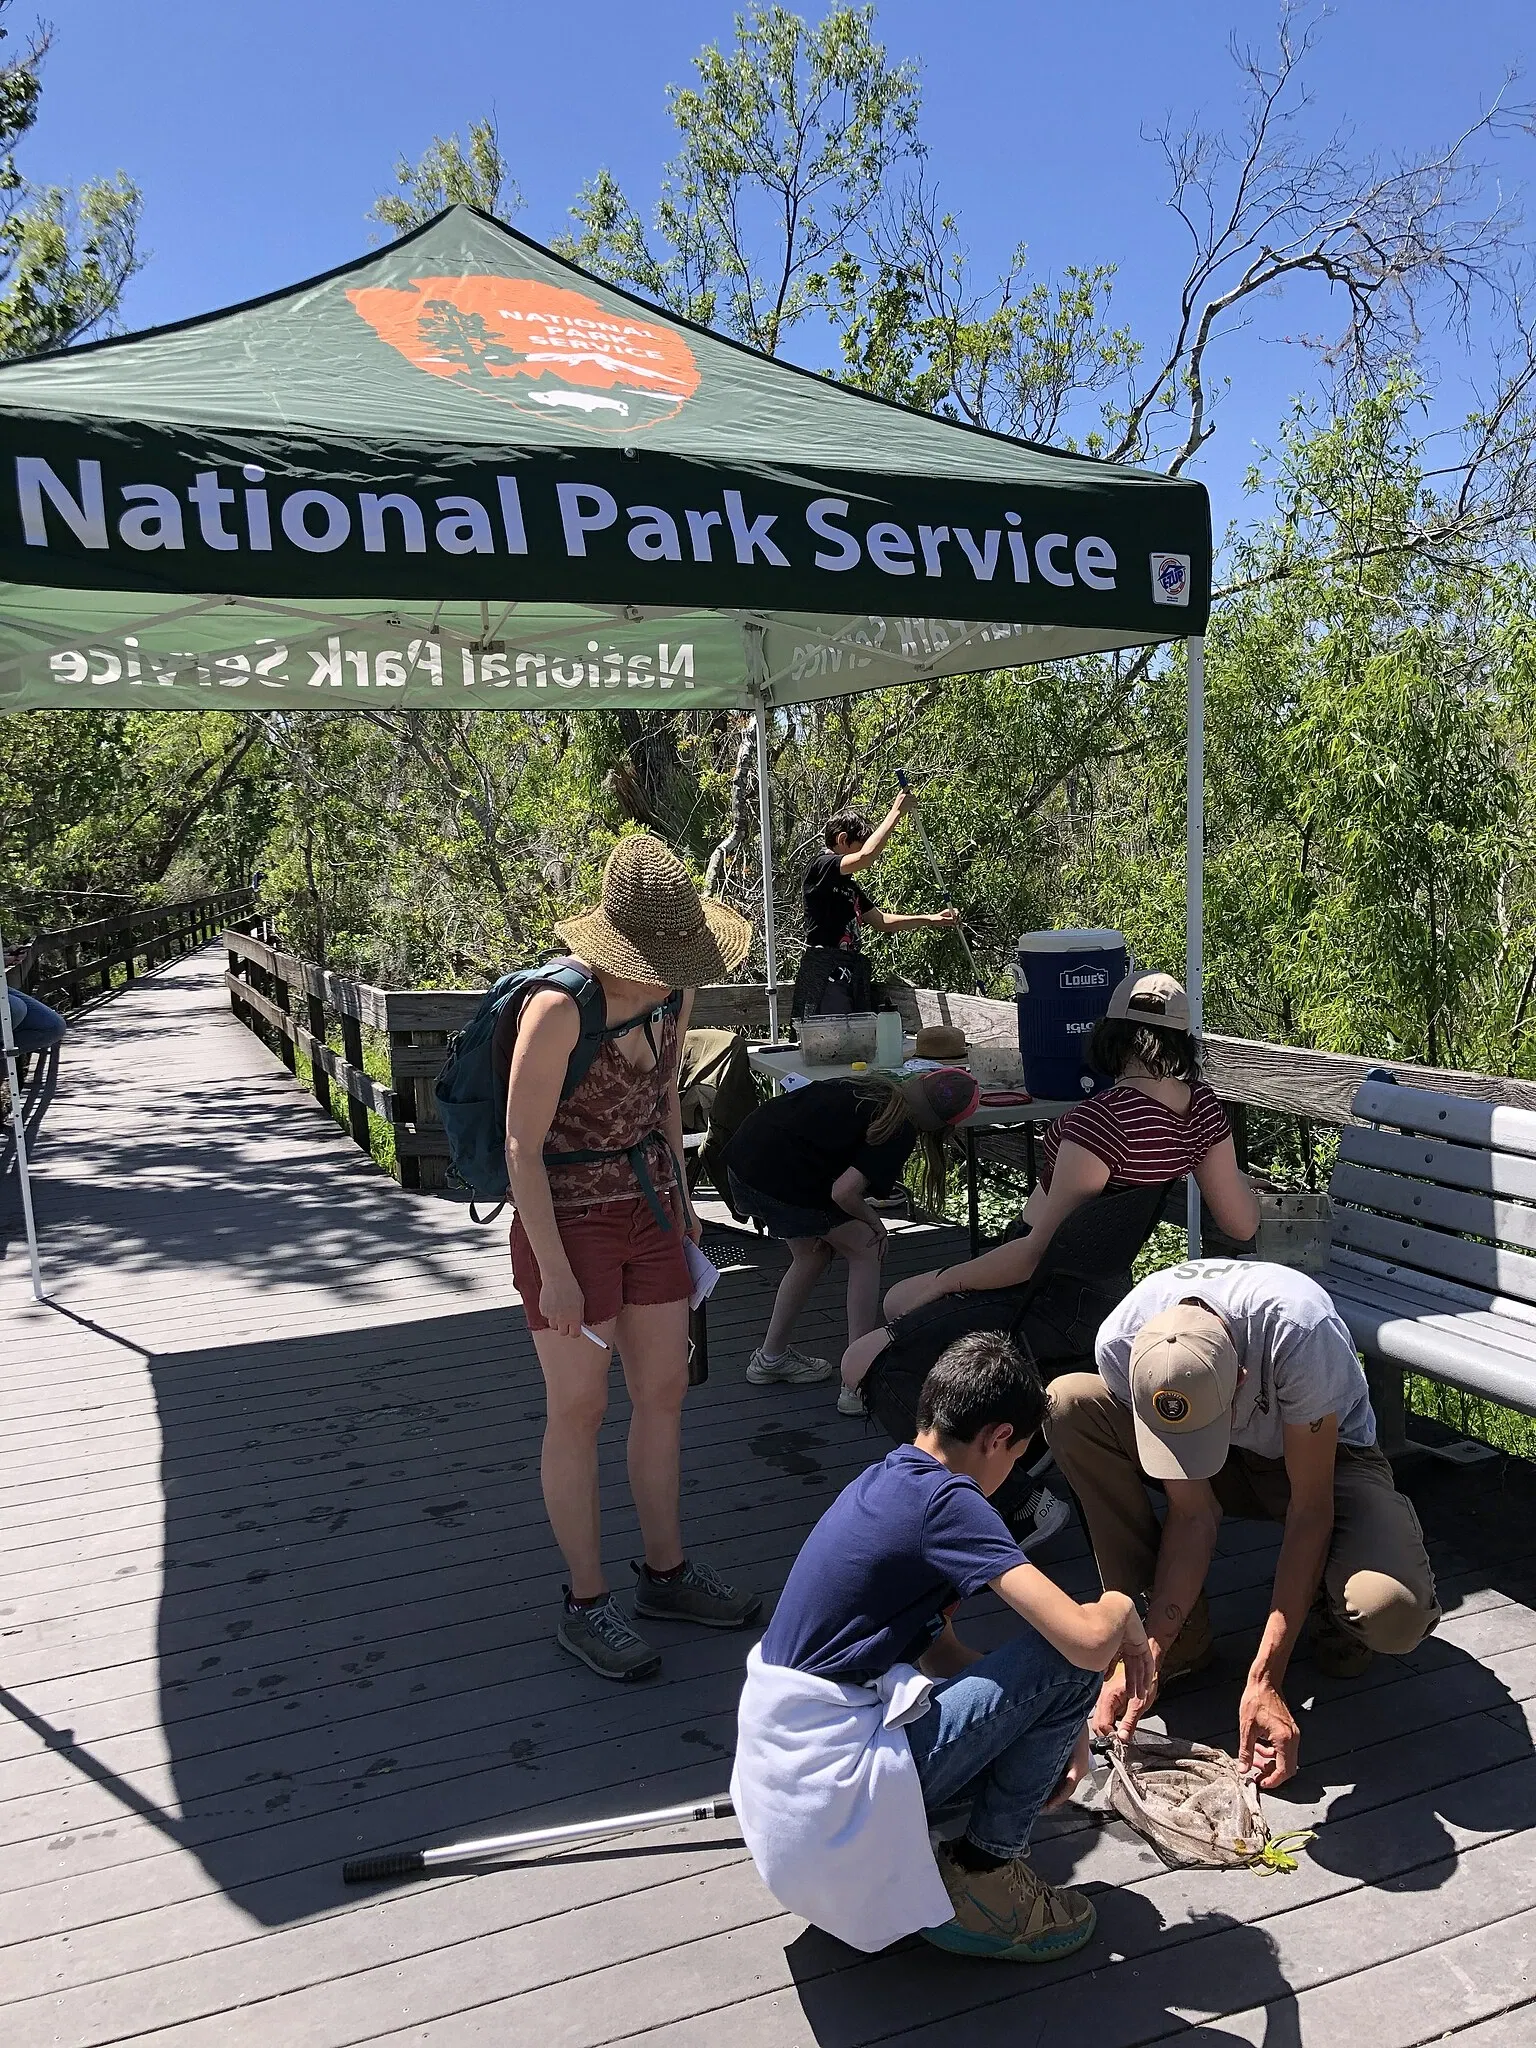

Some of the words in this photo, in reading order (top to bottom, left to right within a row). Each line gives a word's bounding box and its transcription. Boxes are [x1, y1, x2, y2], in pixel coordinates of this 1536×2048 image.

[498, 309, 661, 340] NATIONAL
[545, 326, 633, 346] PARK
[528, 335, 665, 361] SERVICE
[15, 456, 529, 555] National
[555, 482, 792, 567] Park
[805, 497, 1117, 591] Service
[1065, 973, 1105, 986] LOWE'S
[1066, 1022, 1095, 1034] IGLO
[1039, 1495, 1058, 1518] DAN
